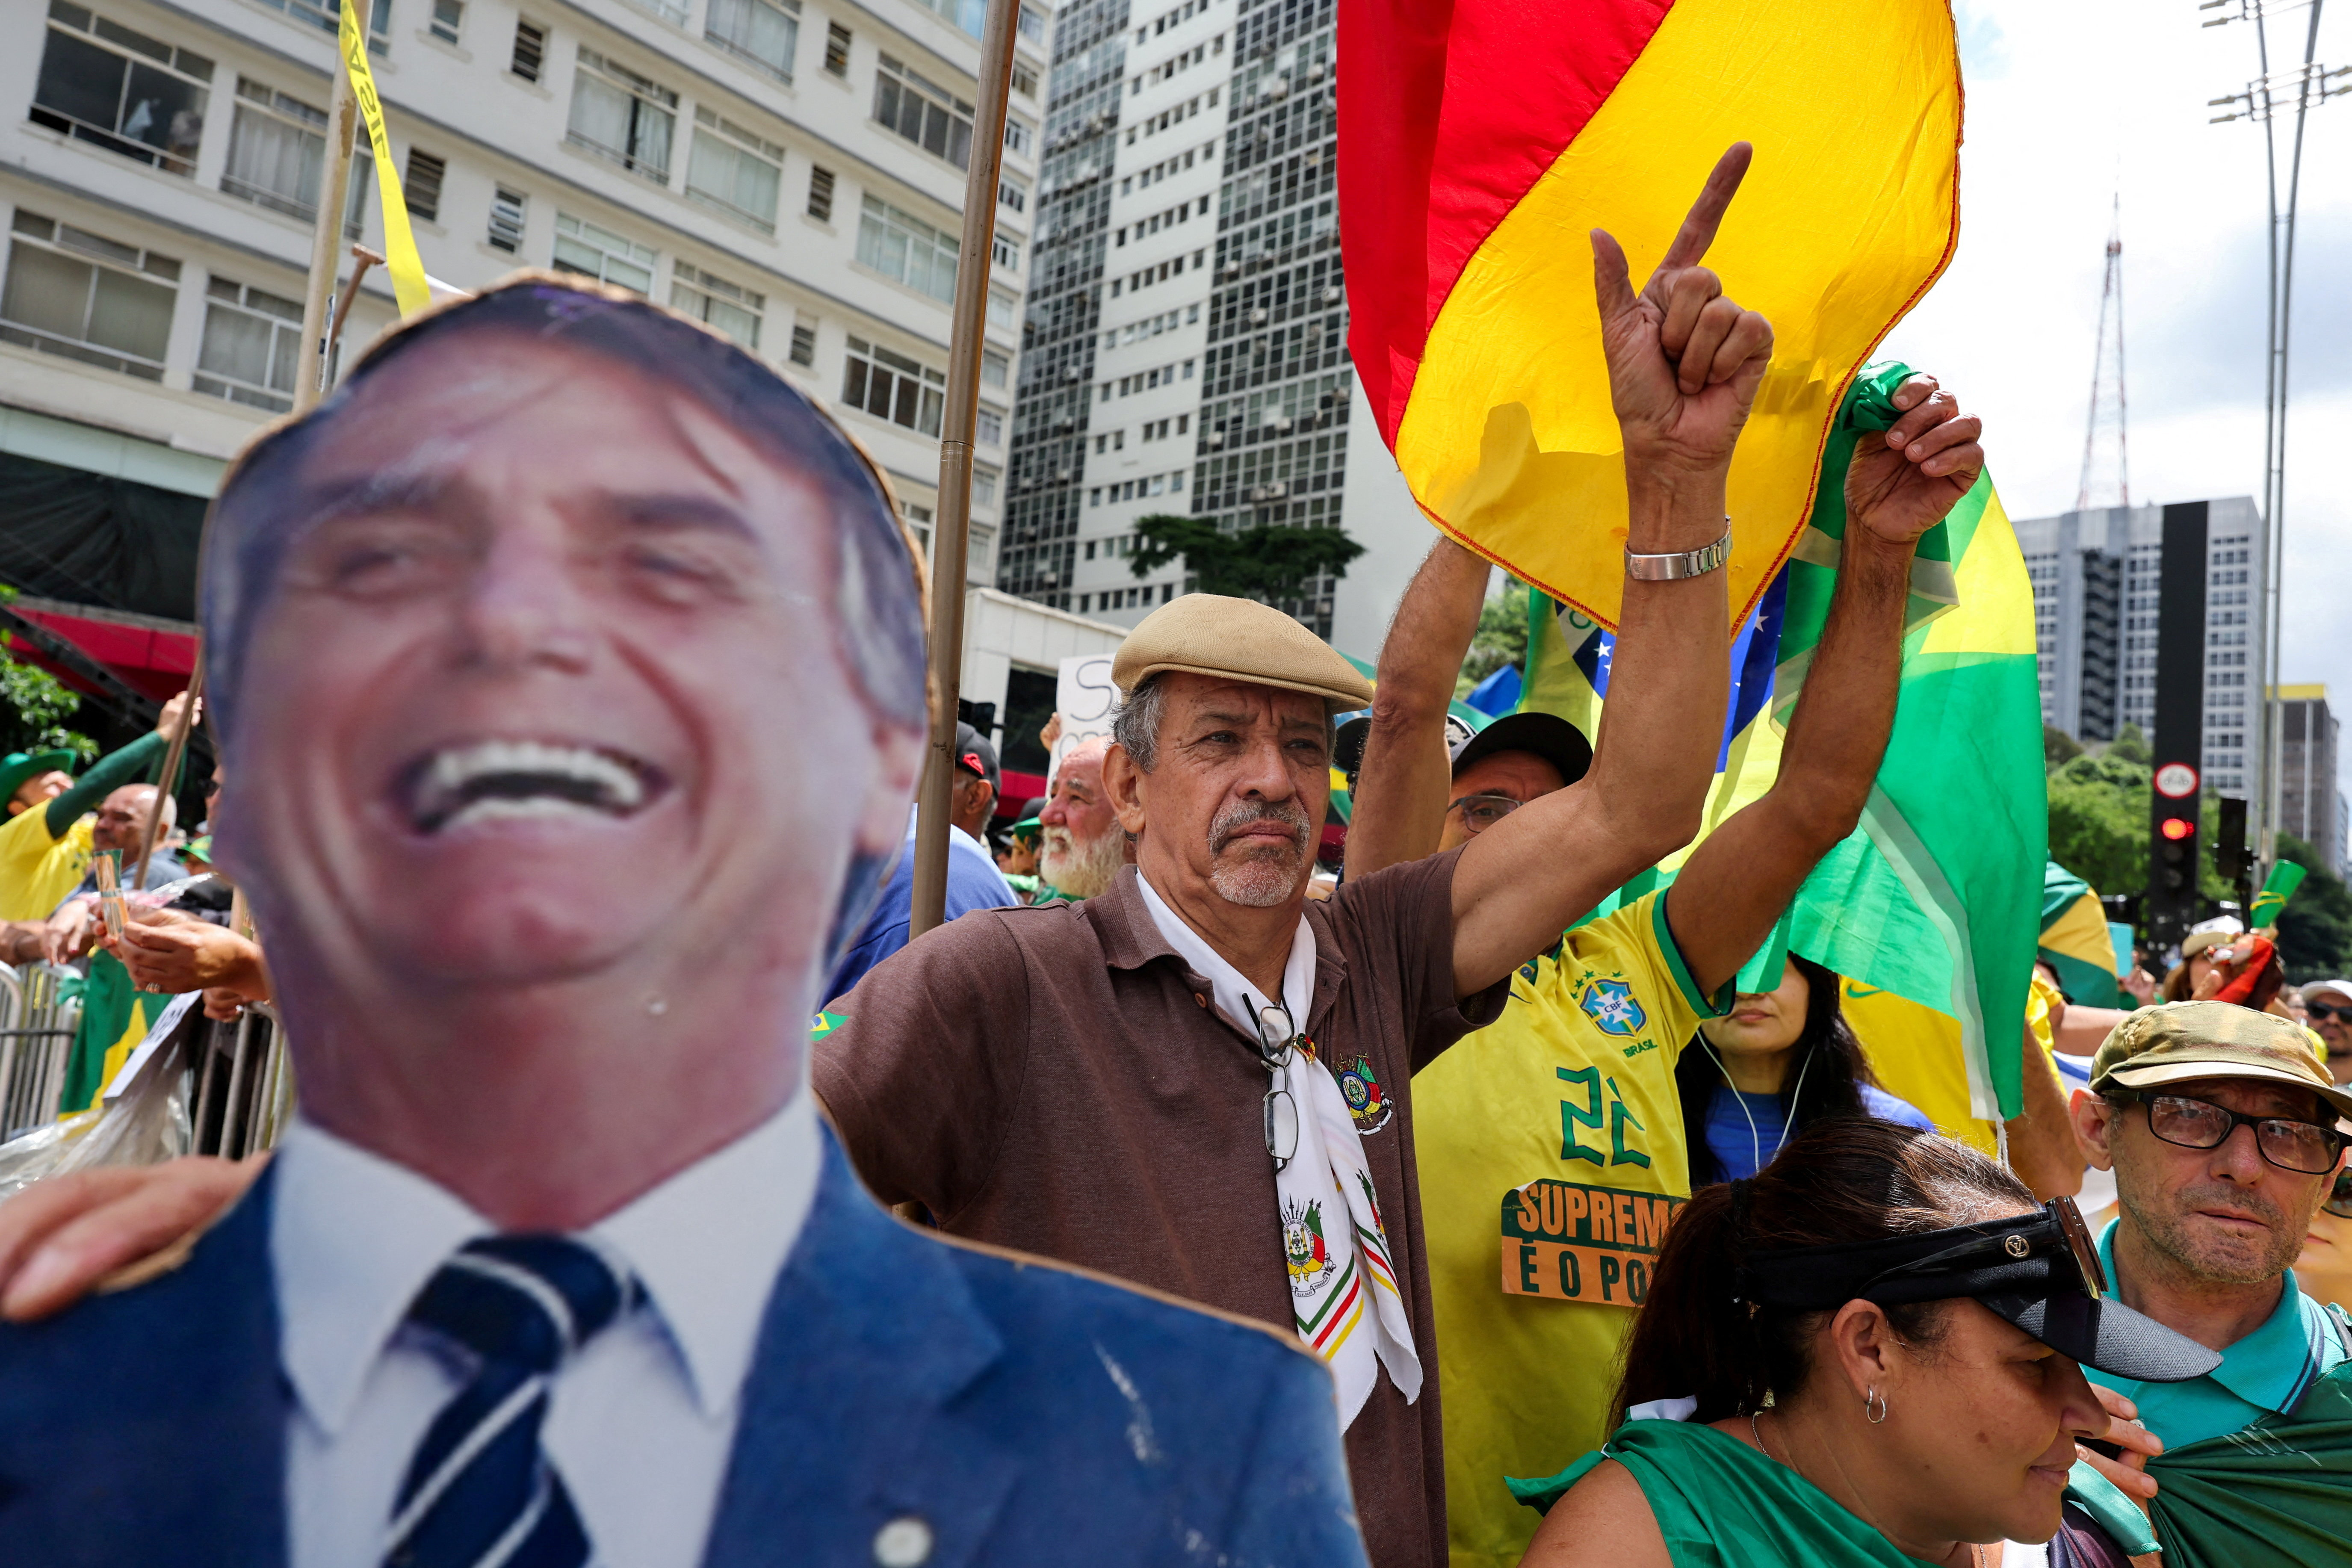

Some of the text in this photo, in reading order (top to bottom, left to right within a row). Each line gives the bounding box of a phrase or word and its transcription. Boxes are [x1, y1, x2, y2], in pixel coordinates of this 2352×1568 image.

[1604, 1001, 1622, 1013] CBF
[1622, 1039, 1658, 1058] BRASIL
[1517, 1183, 1687, 1249] SUPREM
[1559, 1251, 1581, 1298] O
[1599, 1255, 1658, 1305] PO
